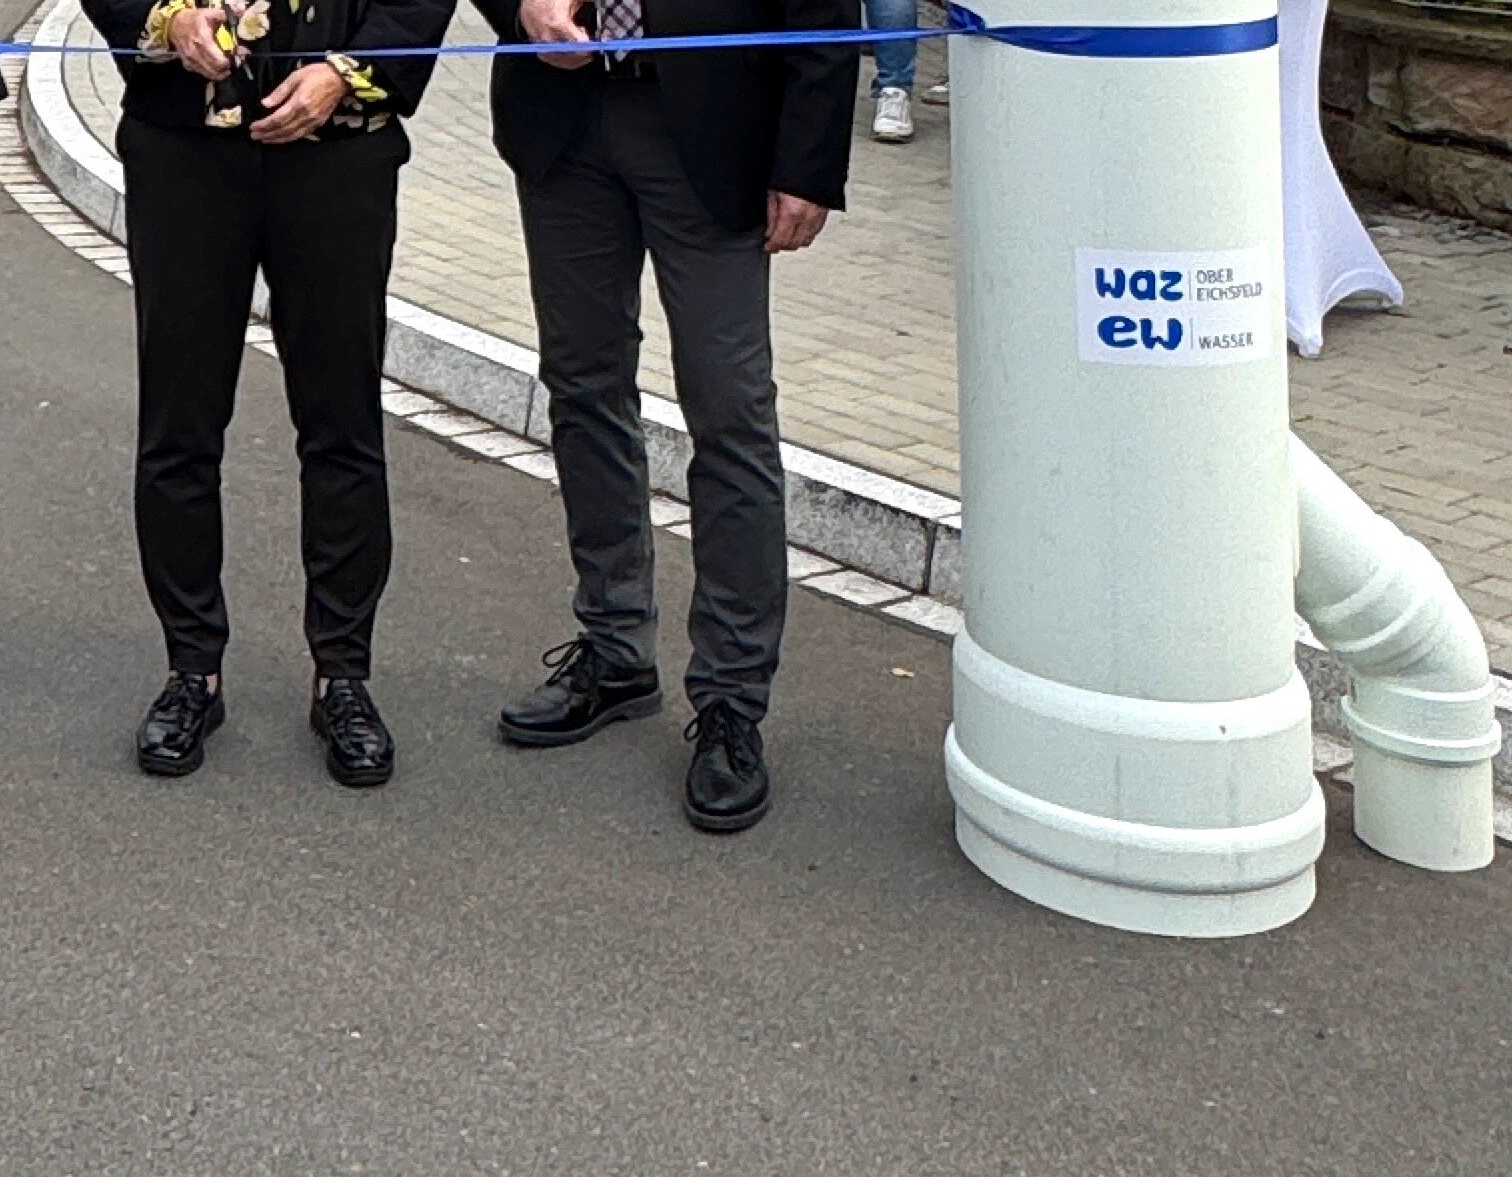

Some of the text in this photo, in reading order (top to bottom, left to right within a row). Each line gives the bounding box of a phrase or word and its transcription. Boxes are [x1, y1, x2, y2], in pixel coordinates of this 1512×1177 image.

[1094, 267, 1184, 301] waz
[1195, 268, 1234, 284] OBER
[1196, 281, 1263, 302] EICHSFELD
[1097, 315, 1184, 350] ew
[1198, 332, 1254, 350] WASSER
